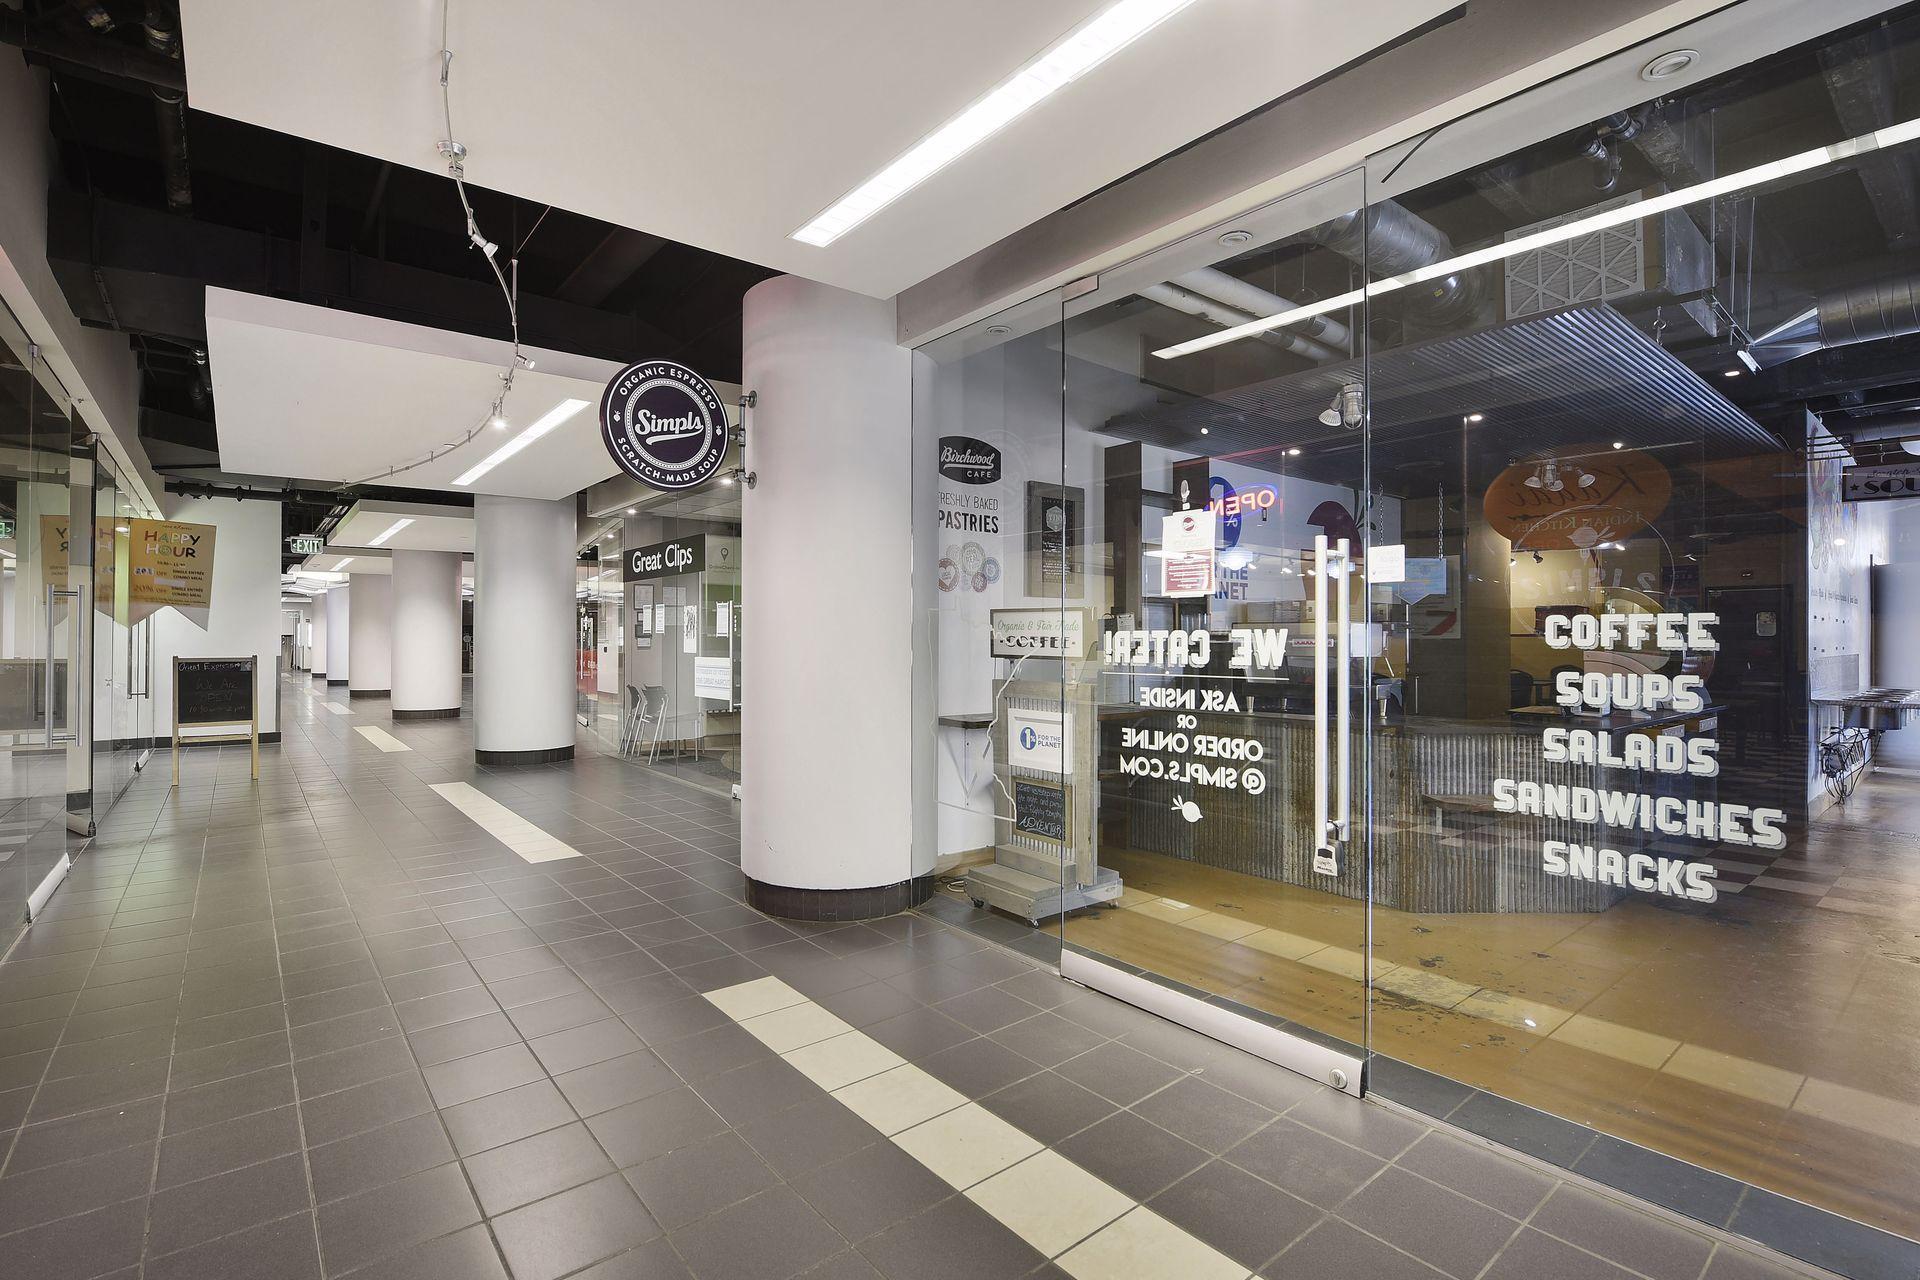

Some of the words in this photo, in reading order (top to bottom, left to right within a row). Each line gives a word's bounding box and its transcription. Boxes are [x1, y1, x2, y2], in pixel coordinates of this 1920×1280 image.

[620, 367, 665, 396] ORGANIC
[670, 368, 716, 410] ESPRESSO
[635, 409, 704, 434] Simpls
[618, 437, 697, 482] SCRATCH-MADE
[698, 448, 719, 473] SOUP
[941, 445, 995, 465] Birchwood
[966, 470, 992, 478] CAFE
[974, 496, 999, 510] BAKED
[938, 510, 999, 534] PASTRIES
[144, 530, 201, 545] HAPPY
[296, 539, 318, 553] EXIT
[145, 544, 196, 558] HOUR
[632, 552, 663, 573] Great
[665, 543, 693, 572] Clips
[997, 620, 1025, 632] Organic
[1037, 620, 1052, 631] Fair
[1544, 611, 1720, 652] COFFEE
[1555, 671, 1705, 713] SOUPS
[1038, 734, 1050, 743] FOR
[1051, 735, 1062, 743] THE
[1038, 741, 1062, 749] PLANET
[1543, 726, 1719, 778] SALADS
[1493, 778, 1787, 850] SANDWICHES
[1543, 841, 1719, 904] SNACKS
